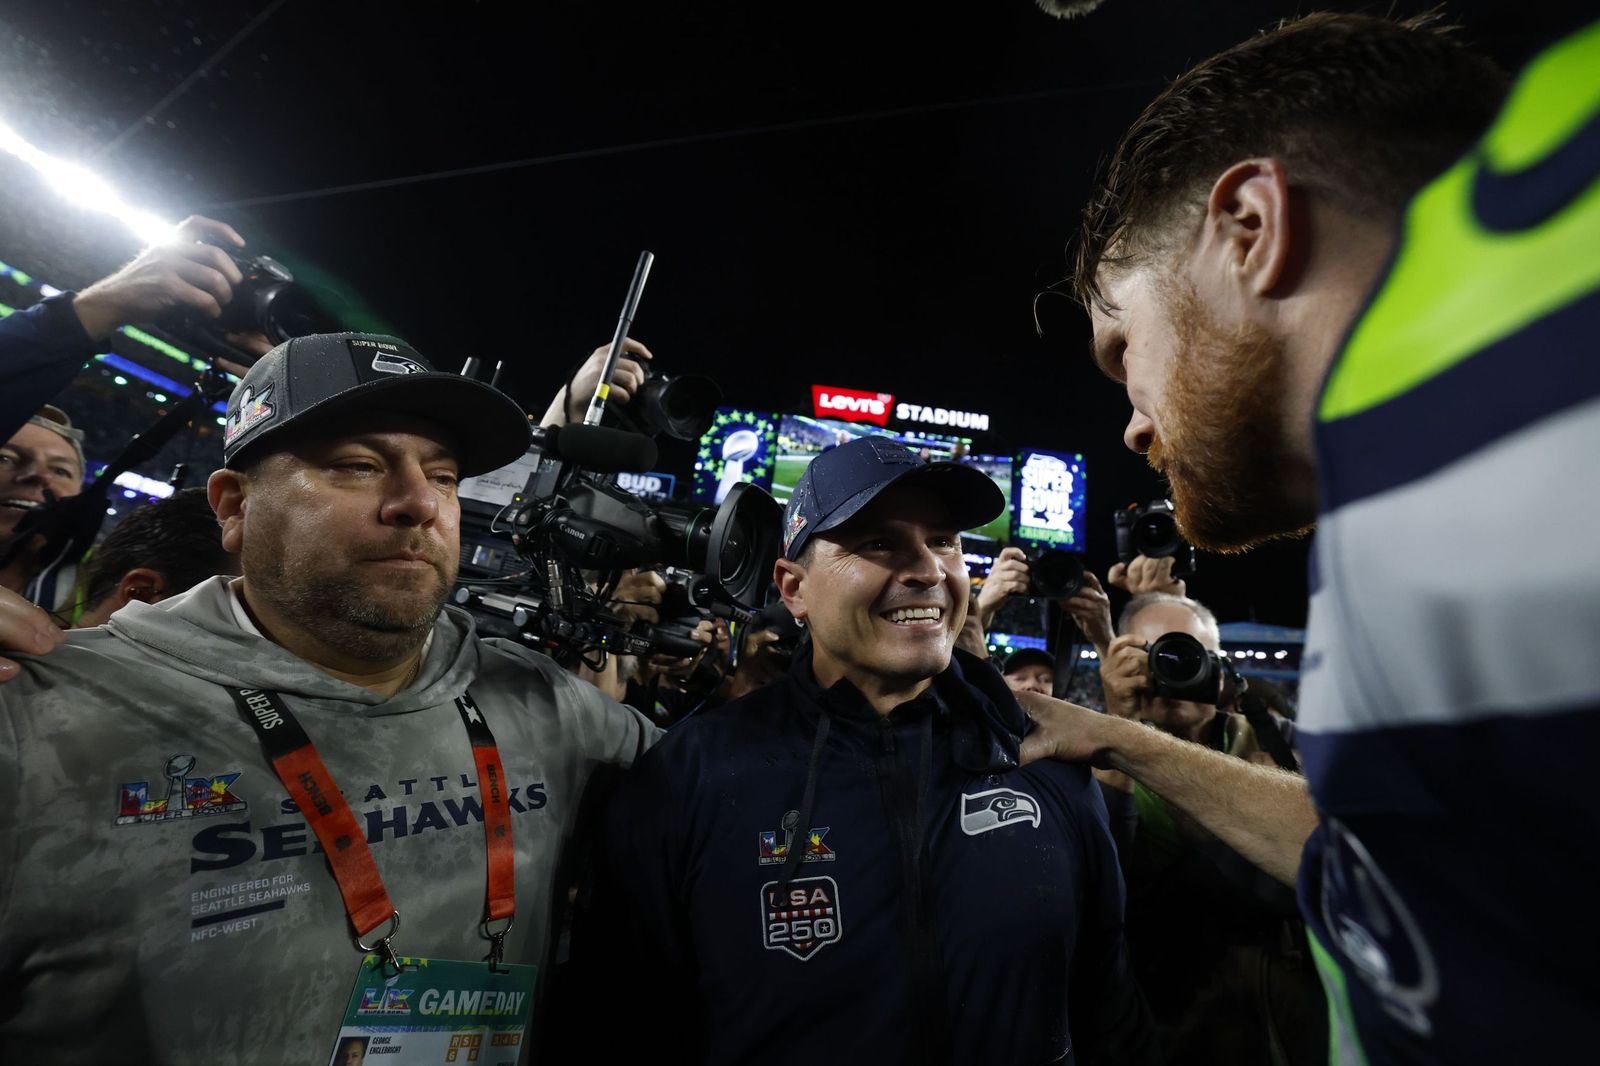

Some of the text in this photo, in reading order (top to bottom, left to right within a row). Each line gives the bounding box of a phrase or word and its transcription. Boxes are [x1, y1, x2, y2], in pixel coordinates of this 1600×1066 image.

[352, 340, 399, 352] SUPER BOWL
[897, 403, 988, 431] STADIUM
[617, 472, 661, 492] BUD
[1021, 466, 1074, 493] SUPER
[1021, 487, 1069, 515] BOWL
[559, 523, 585, 541] Canon
[1021, 509, 1074, 532] LX
[246, 693, 284, 730] SUPER
[281, 774, 477, 815] SATTL
[297, 771, 332, 816] BENCH
[486, 763, 501, 804] BENCH
[191, 783, 547, 874] SEHAWKS
[191, 874, 294, 902] ENGINEERED FOR
[191, 883, 311, 916] SEATTLE SEAHAWKS
[191, 918, 258, 943] NFC-WEST
[768, 917, 836, 943] 250
[418, 988, 526, 1016] GAMEDAY
[369, 1046, 402, 1055] ENGLEBRIGHT
[372, 1036, 391, 1045] GEORGE
